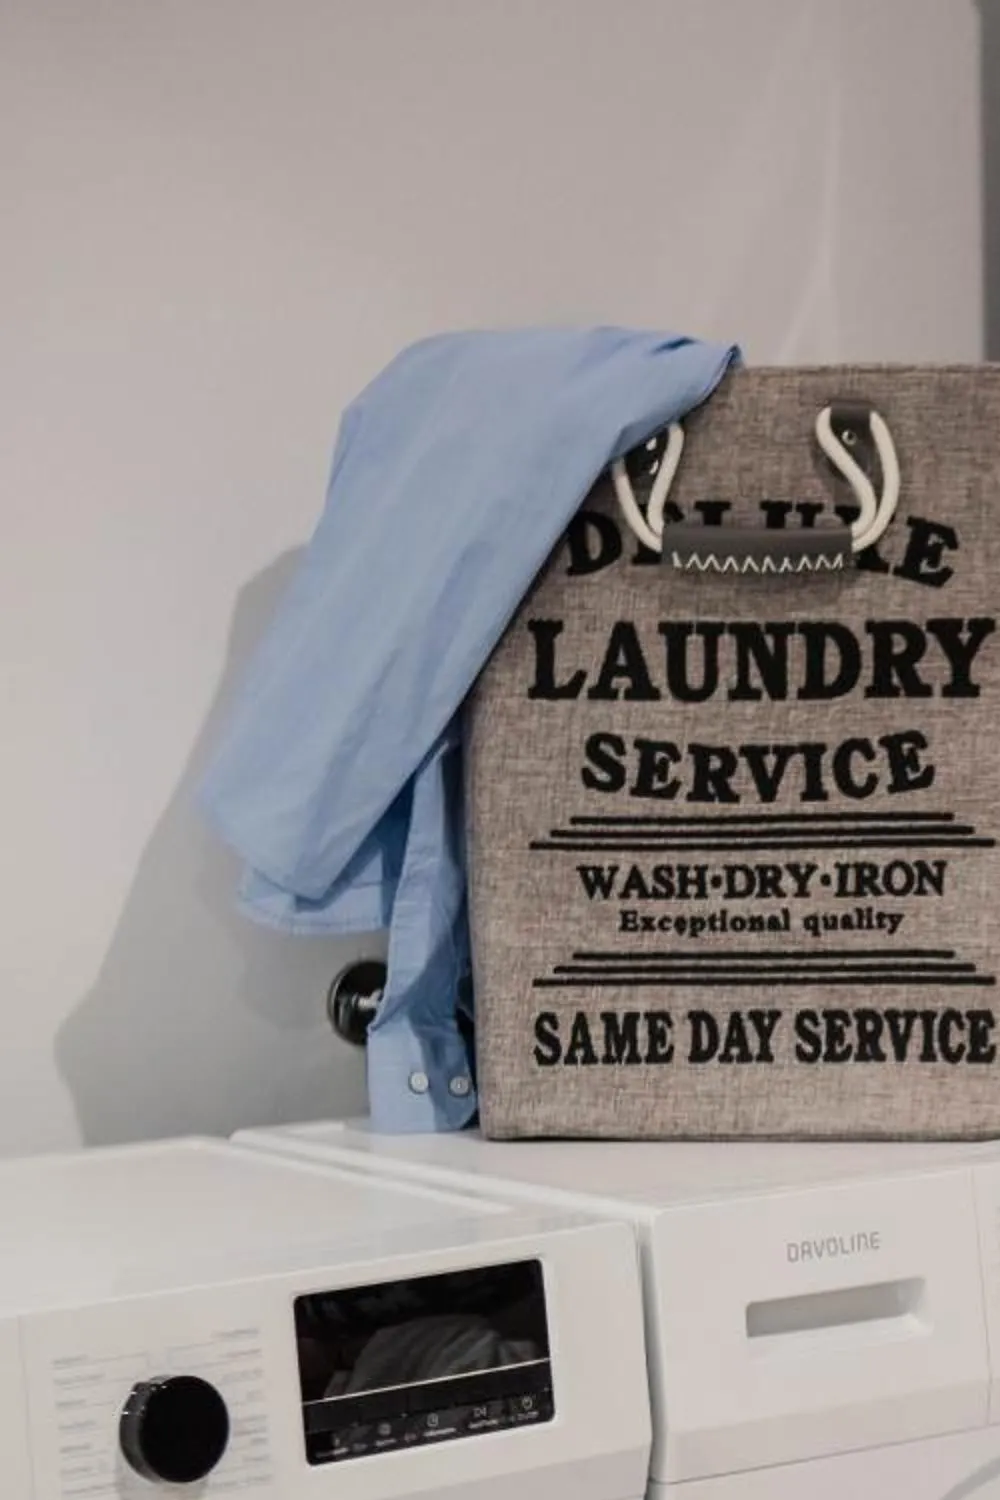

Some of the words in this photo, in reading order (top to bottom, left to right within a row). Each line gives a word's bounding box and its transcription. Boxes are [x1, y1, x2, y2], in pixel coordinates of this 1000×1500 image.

[527, 617, 996, 703] LAUNDRY
[581, 730, 934, 803] SERVICE
[619, 908, 790, 938] Exceptional
[804, 907, 904, 937] quality
[534, 1011, 674, 1066] SAME
[688, 1010, 781, 1064] DAY
[795, 1009, 996, 1065] SERVICE
[786, 1231, 882, 1263] DAVOLINE
